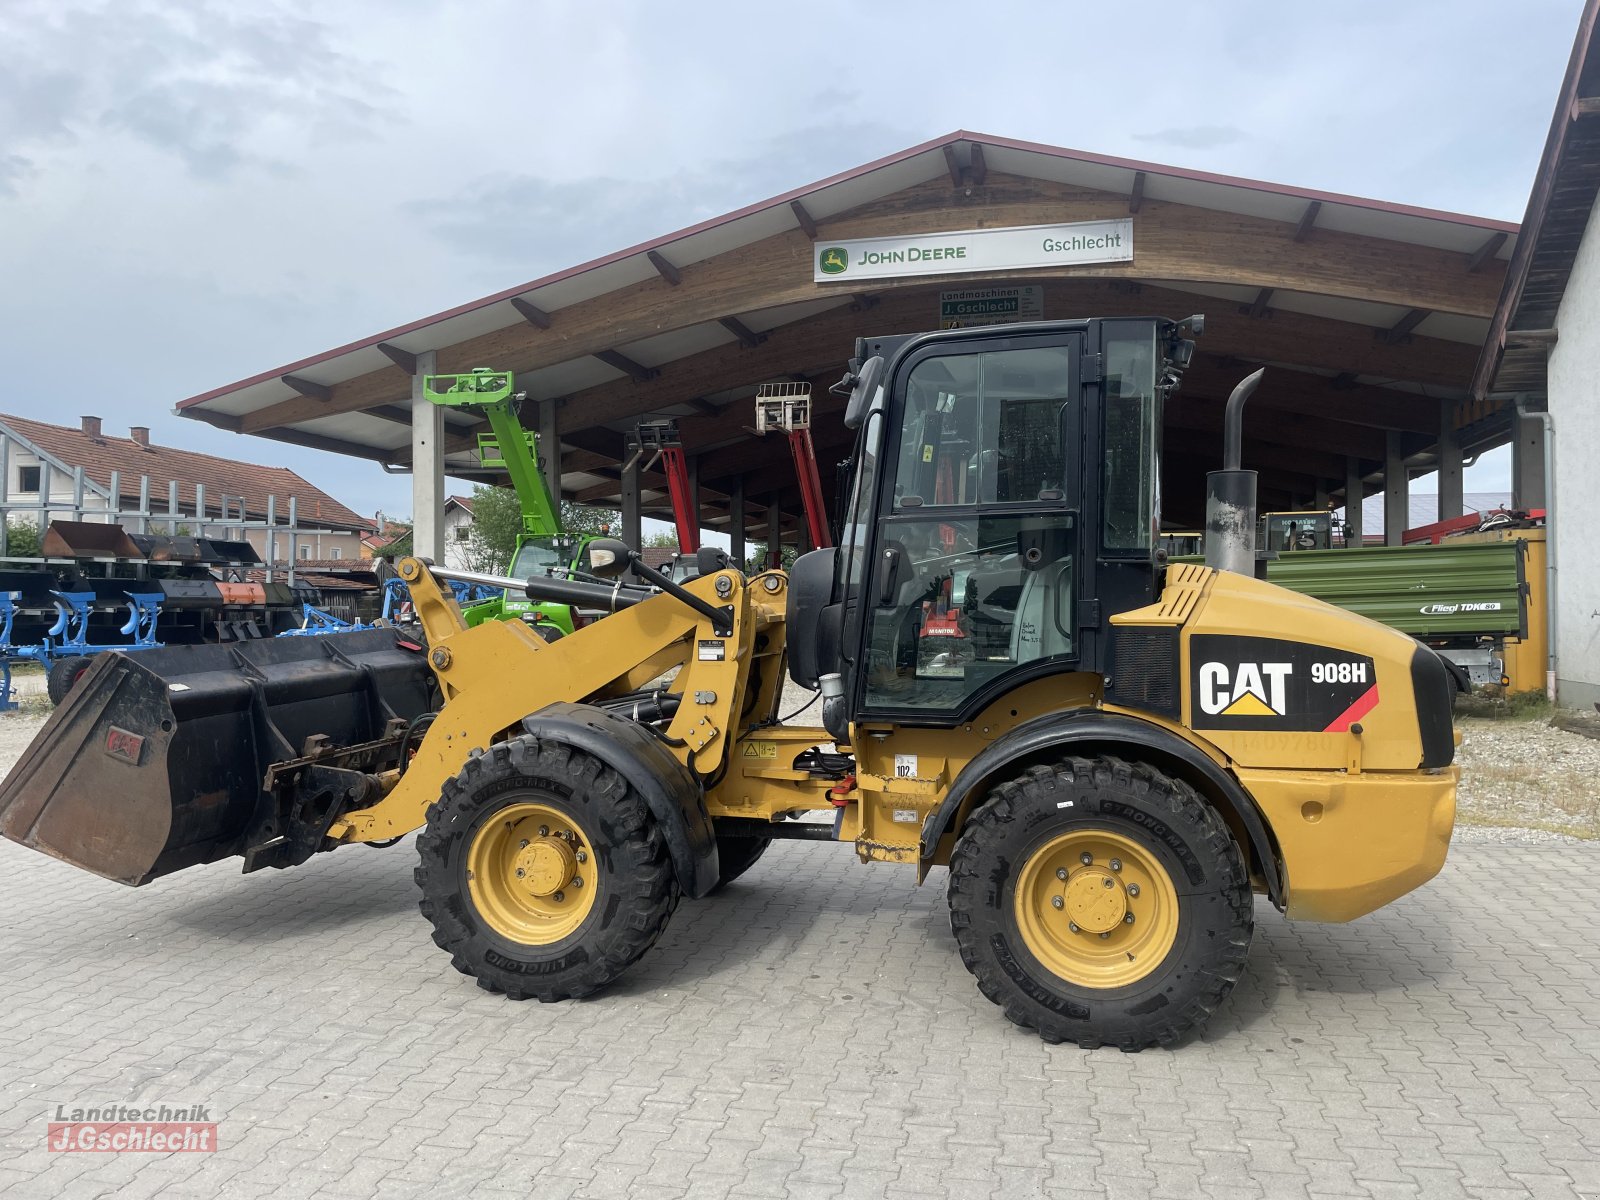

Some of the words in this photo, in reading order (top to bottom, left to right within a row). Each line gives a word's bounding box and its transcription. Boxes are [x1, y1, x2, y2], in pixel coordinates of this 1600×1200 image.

[1042, 233, 1121, 252] Gschlecht
[857, 250, 905, 266] JOHN
[908, 246, 967, 262] DEERE
[942, 288, 1019, 300] Landmaschinen
[945, 304, 954, 314] J.
[957, 301, 1016, 313] Gschlecht
[1431, 603, 1458, 613] Fliegl
[1461, 602, 1482, 611] TDK
[1200, 661, 1293, 716] CAT
[1311, 662, 1367, 684] 908H
[896, 765, 910, 778] 102
